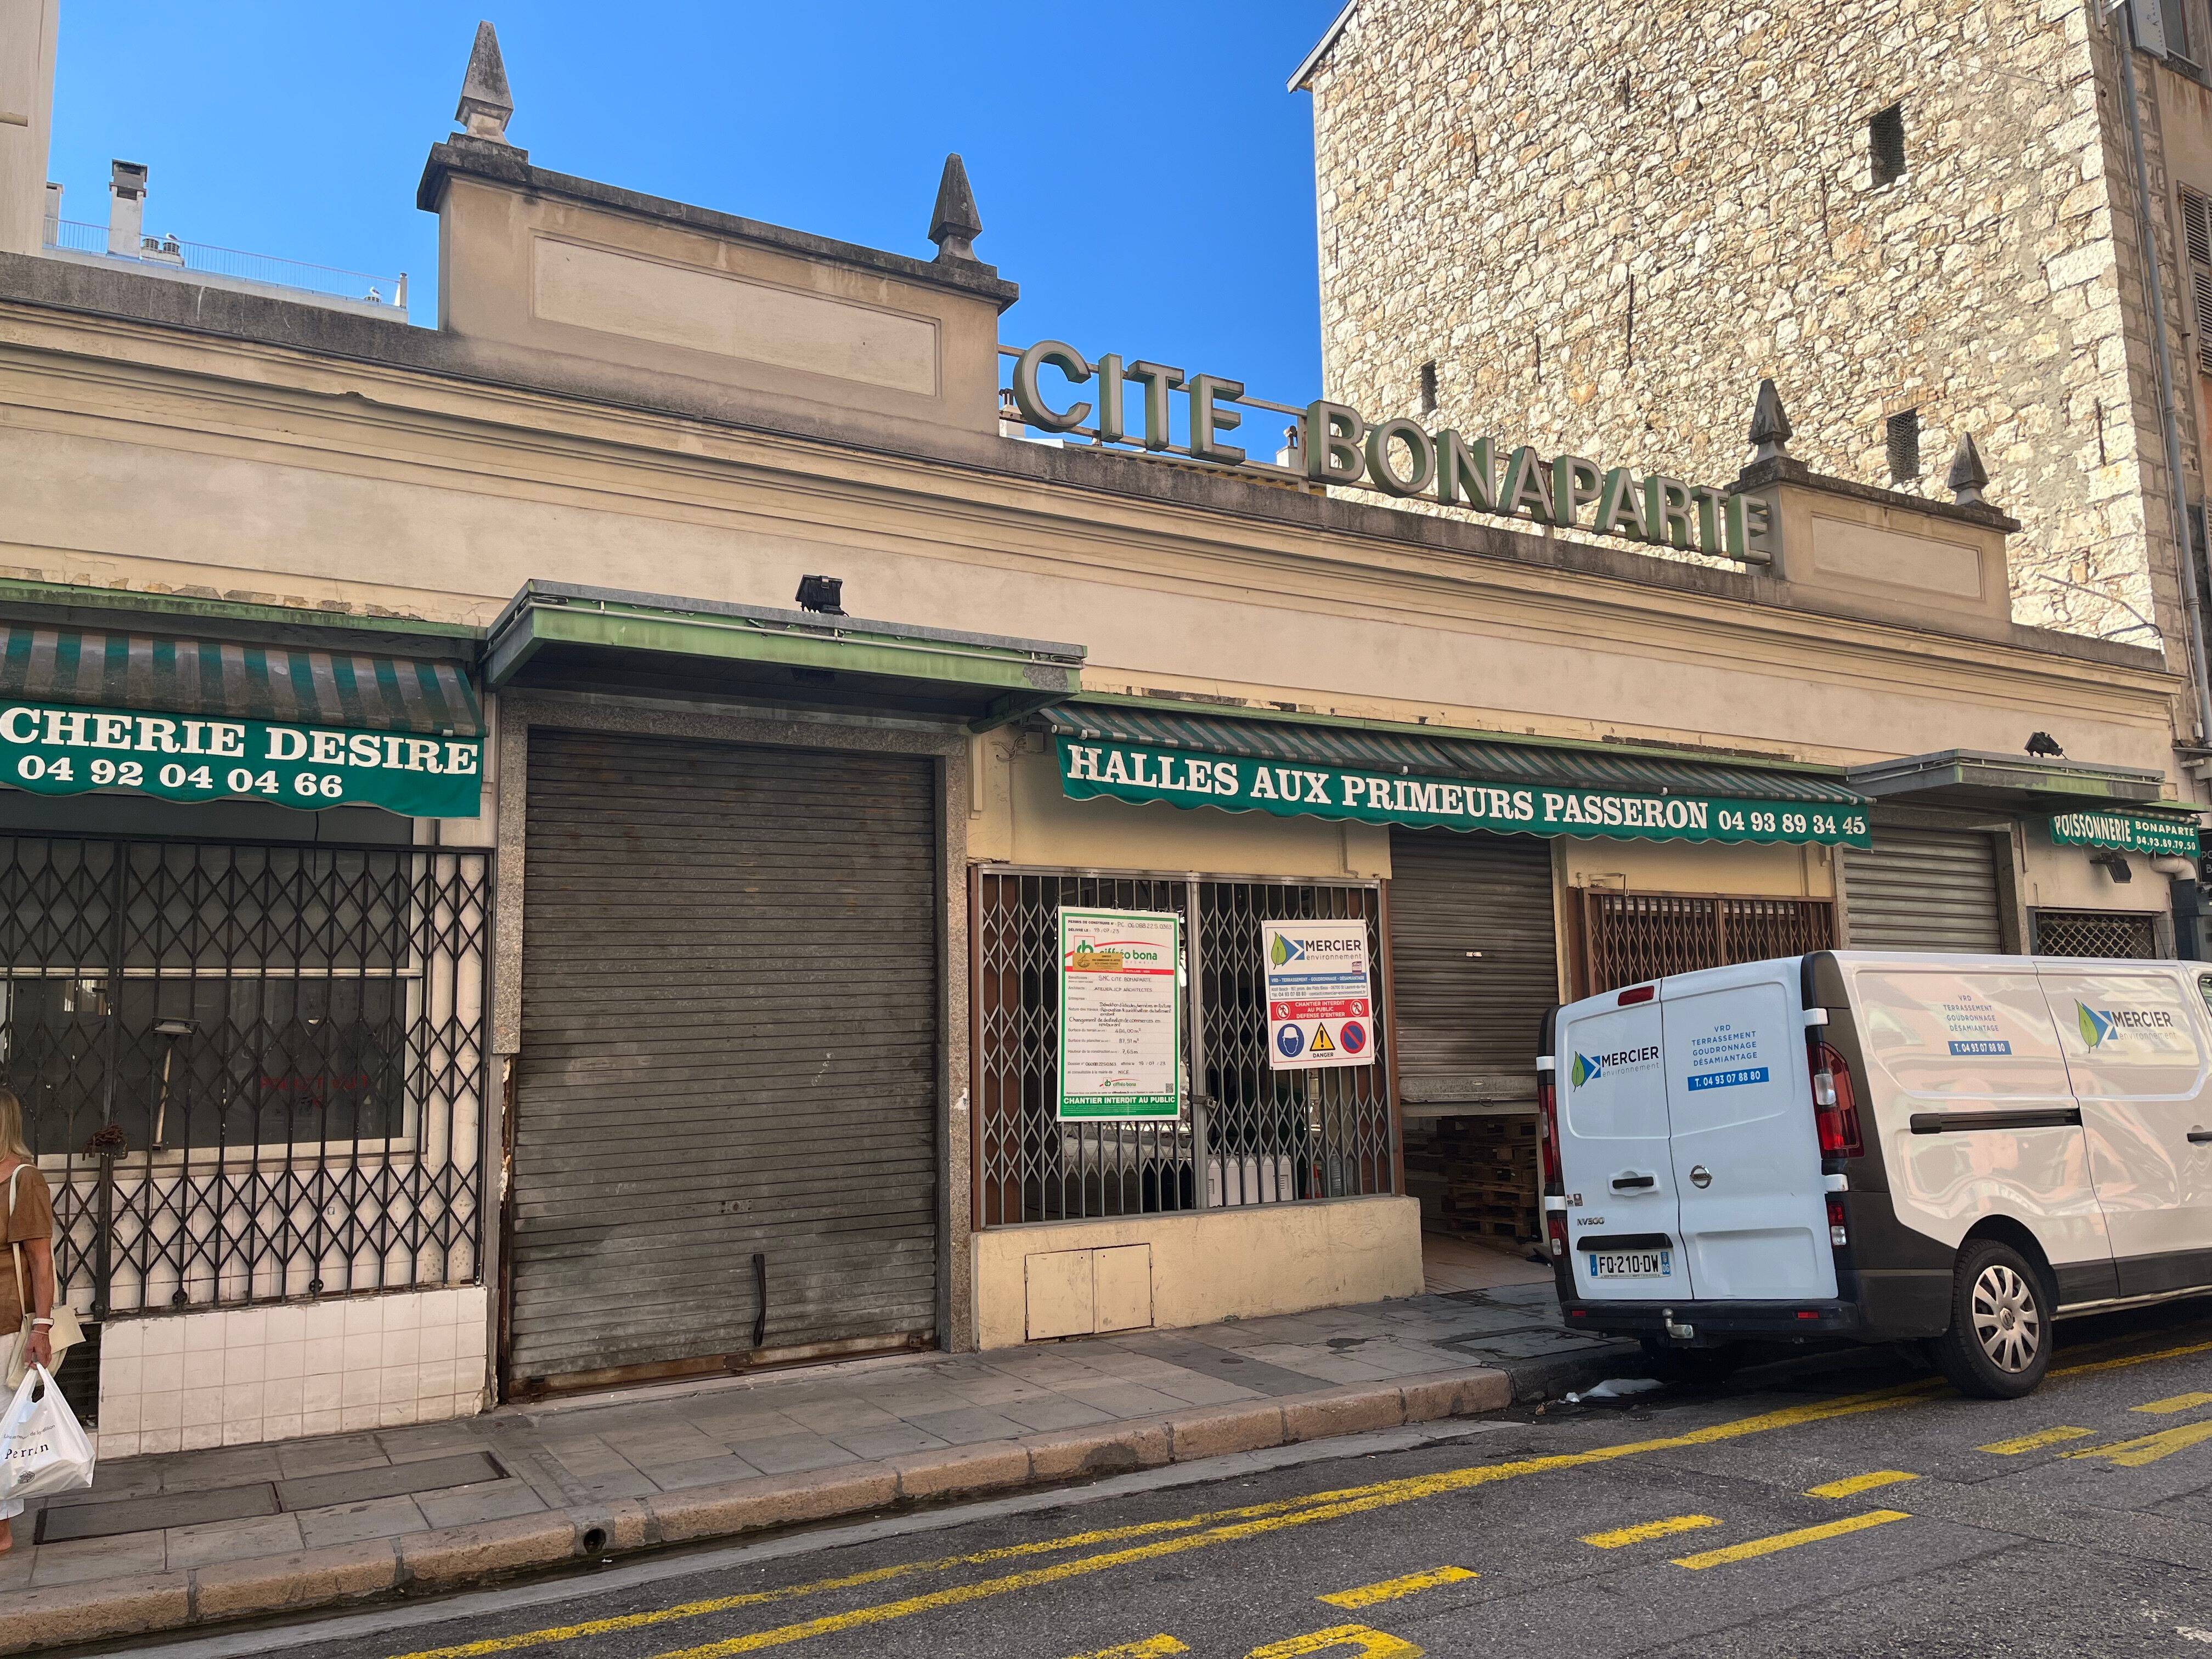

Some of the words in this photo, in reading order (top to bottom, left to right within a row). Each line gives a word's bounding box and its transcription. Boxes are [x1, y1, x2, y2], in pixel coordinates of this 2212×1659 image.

[1013, 340, 1246, 464] CITE
[1307, 399, 1772, 566] BONAPARTE
[0, 707, 245, 758] CHERIE
[264, 727, 478, 775] DESIRE
[18, 755, 74, 782] 04
[91, 760, 143, 786] 92
[159, 763, 213, 789] 04
[227, 769, 279, 794] 04
[294, 772, 343, 798] 66
[1066, 744, 1238, 796] HALLES
[1250, 766, 1331, 804] AUX
[1341, 775, 1534, 820] PRIMEURS
[1543, 792, 1708, 830] PASSERON
[1719, 810, 1745, 831] 04
[1751, 812, 1775, 833] 93
[1782, 814, 1807, 834] 89
[1813, 815, 1836, 834] 34
[1842, 816, 1866, 834] 45
[2054, 814, 2132, 842] POISSONNERIE
[2135, 821, 2194, 836] BONAPARTE
[2136, 835, 2196, 850] 04.93.89.79.50
[1306, 940, 1362, 952] MERCIER
[1132, 950, 1158, 960] bona
[2111, 1011, 2174, 1028] MERCIER
[1714, 1024, 1731, 1032] VRD
[1950, 1023, 1999, 1032] DÉSAMIANTAGE
[1691, 1030, 1757, 1046] TERRASSEMENT
[2119, 1030, 2177, 1041] environnement
[1692, 1041, 1757, 1057] GOUDRONNAGE
[1955, 1043, 1961, 1052] T.
[1962, 1043, 1970, 1052] 04
[1971, 1043, 1979, 1052] 93
[1980, 1043, 1988, 1052] 07
[1989, 1043, 1996, 1052] 88
[1997, 1043, 2005, 1052] 80
[1601, 1046, 1659, 1067] MERCIER
[1693, 1051, 1758, 1066] DÉSAMIANTAGE
[1602, 1062, 1660, 1077] environnement
[1695, 1078, 1701, 1087] T.
[1703, 1076, 1712, 1086] 04
[1715, 1075, 1724, 1085] 93
[1726, 1074, 1736, 1084] 07
[1739, 1073, 1748, 1082] 88
[1751, 1071, 1760, 1081] 80
[1599, 1255, 1658, 1273] FQ-210-DW
[5, 1444, 49, 1459] Perrin
